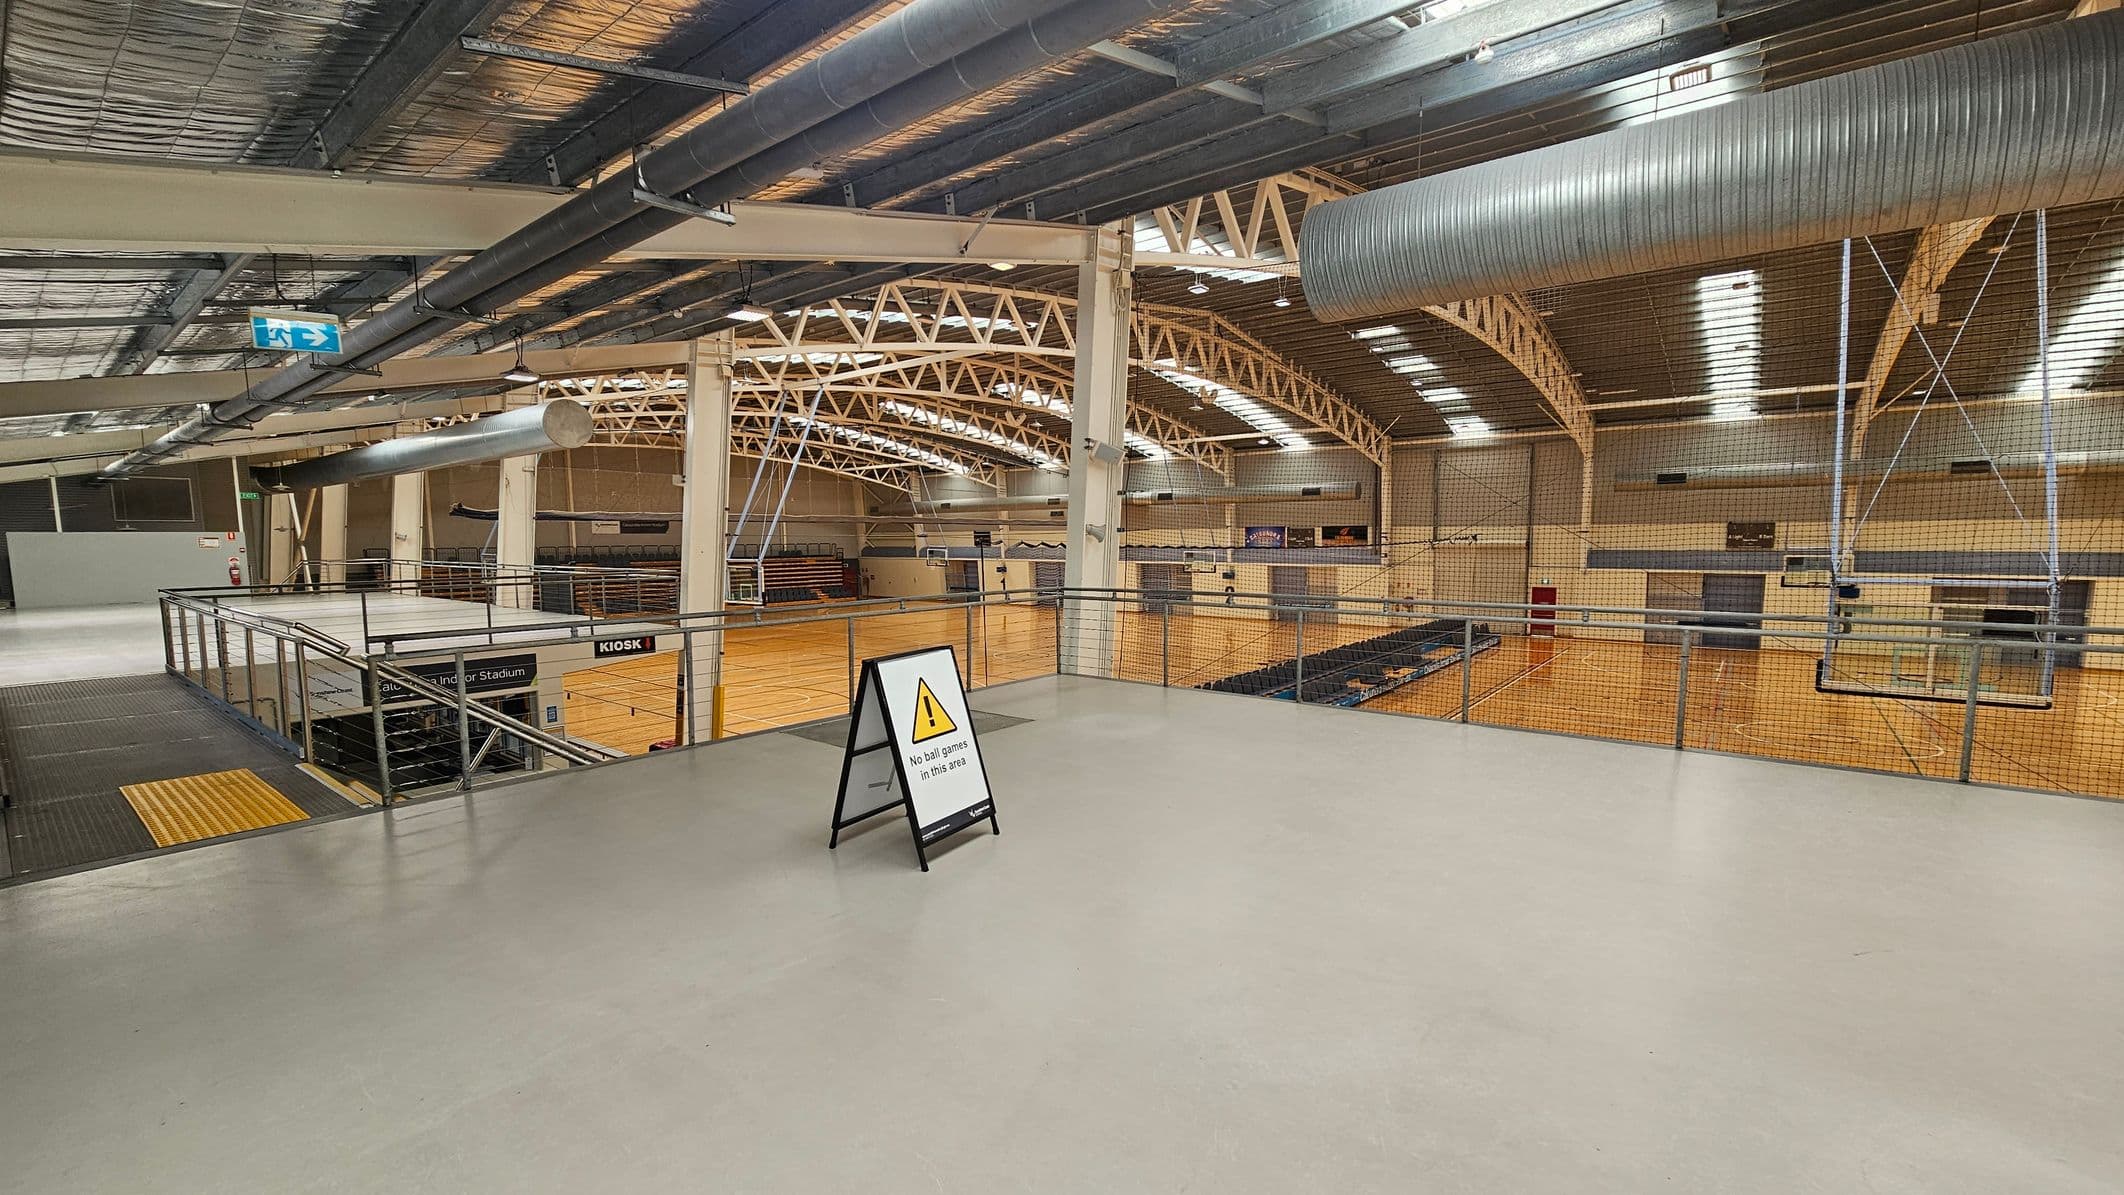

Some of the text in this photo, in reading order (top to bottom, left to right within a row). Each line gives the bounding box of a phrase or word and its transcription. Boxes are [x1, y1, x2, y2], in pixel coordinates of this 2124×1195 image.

[599, 639, 642, 652] KIOSK
[440, 671, 477, 687] Indor
[479, 667, 526, 681] Stadium
[909, 740, 968, 767] No ball games
[920, 757, 967, 781] in this area
